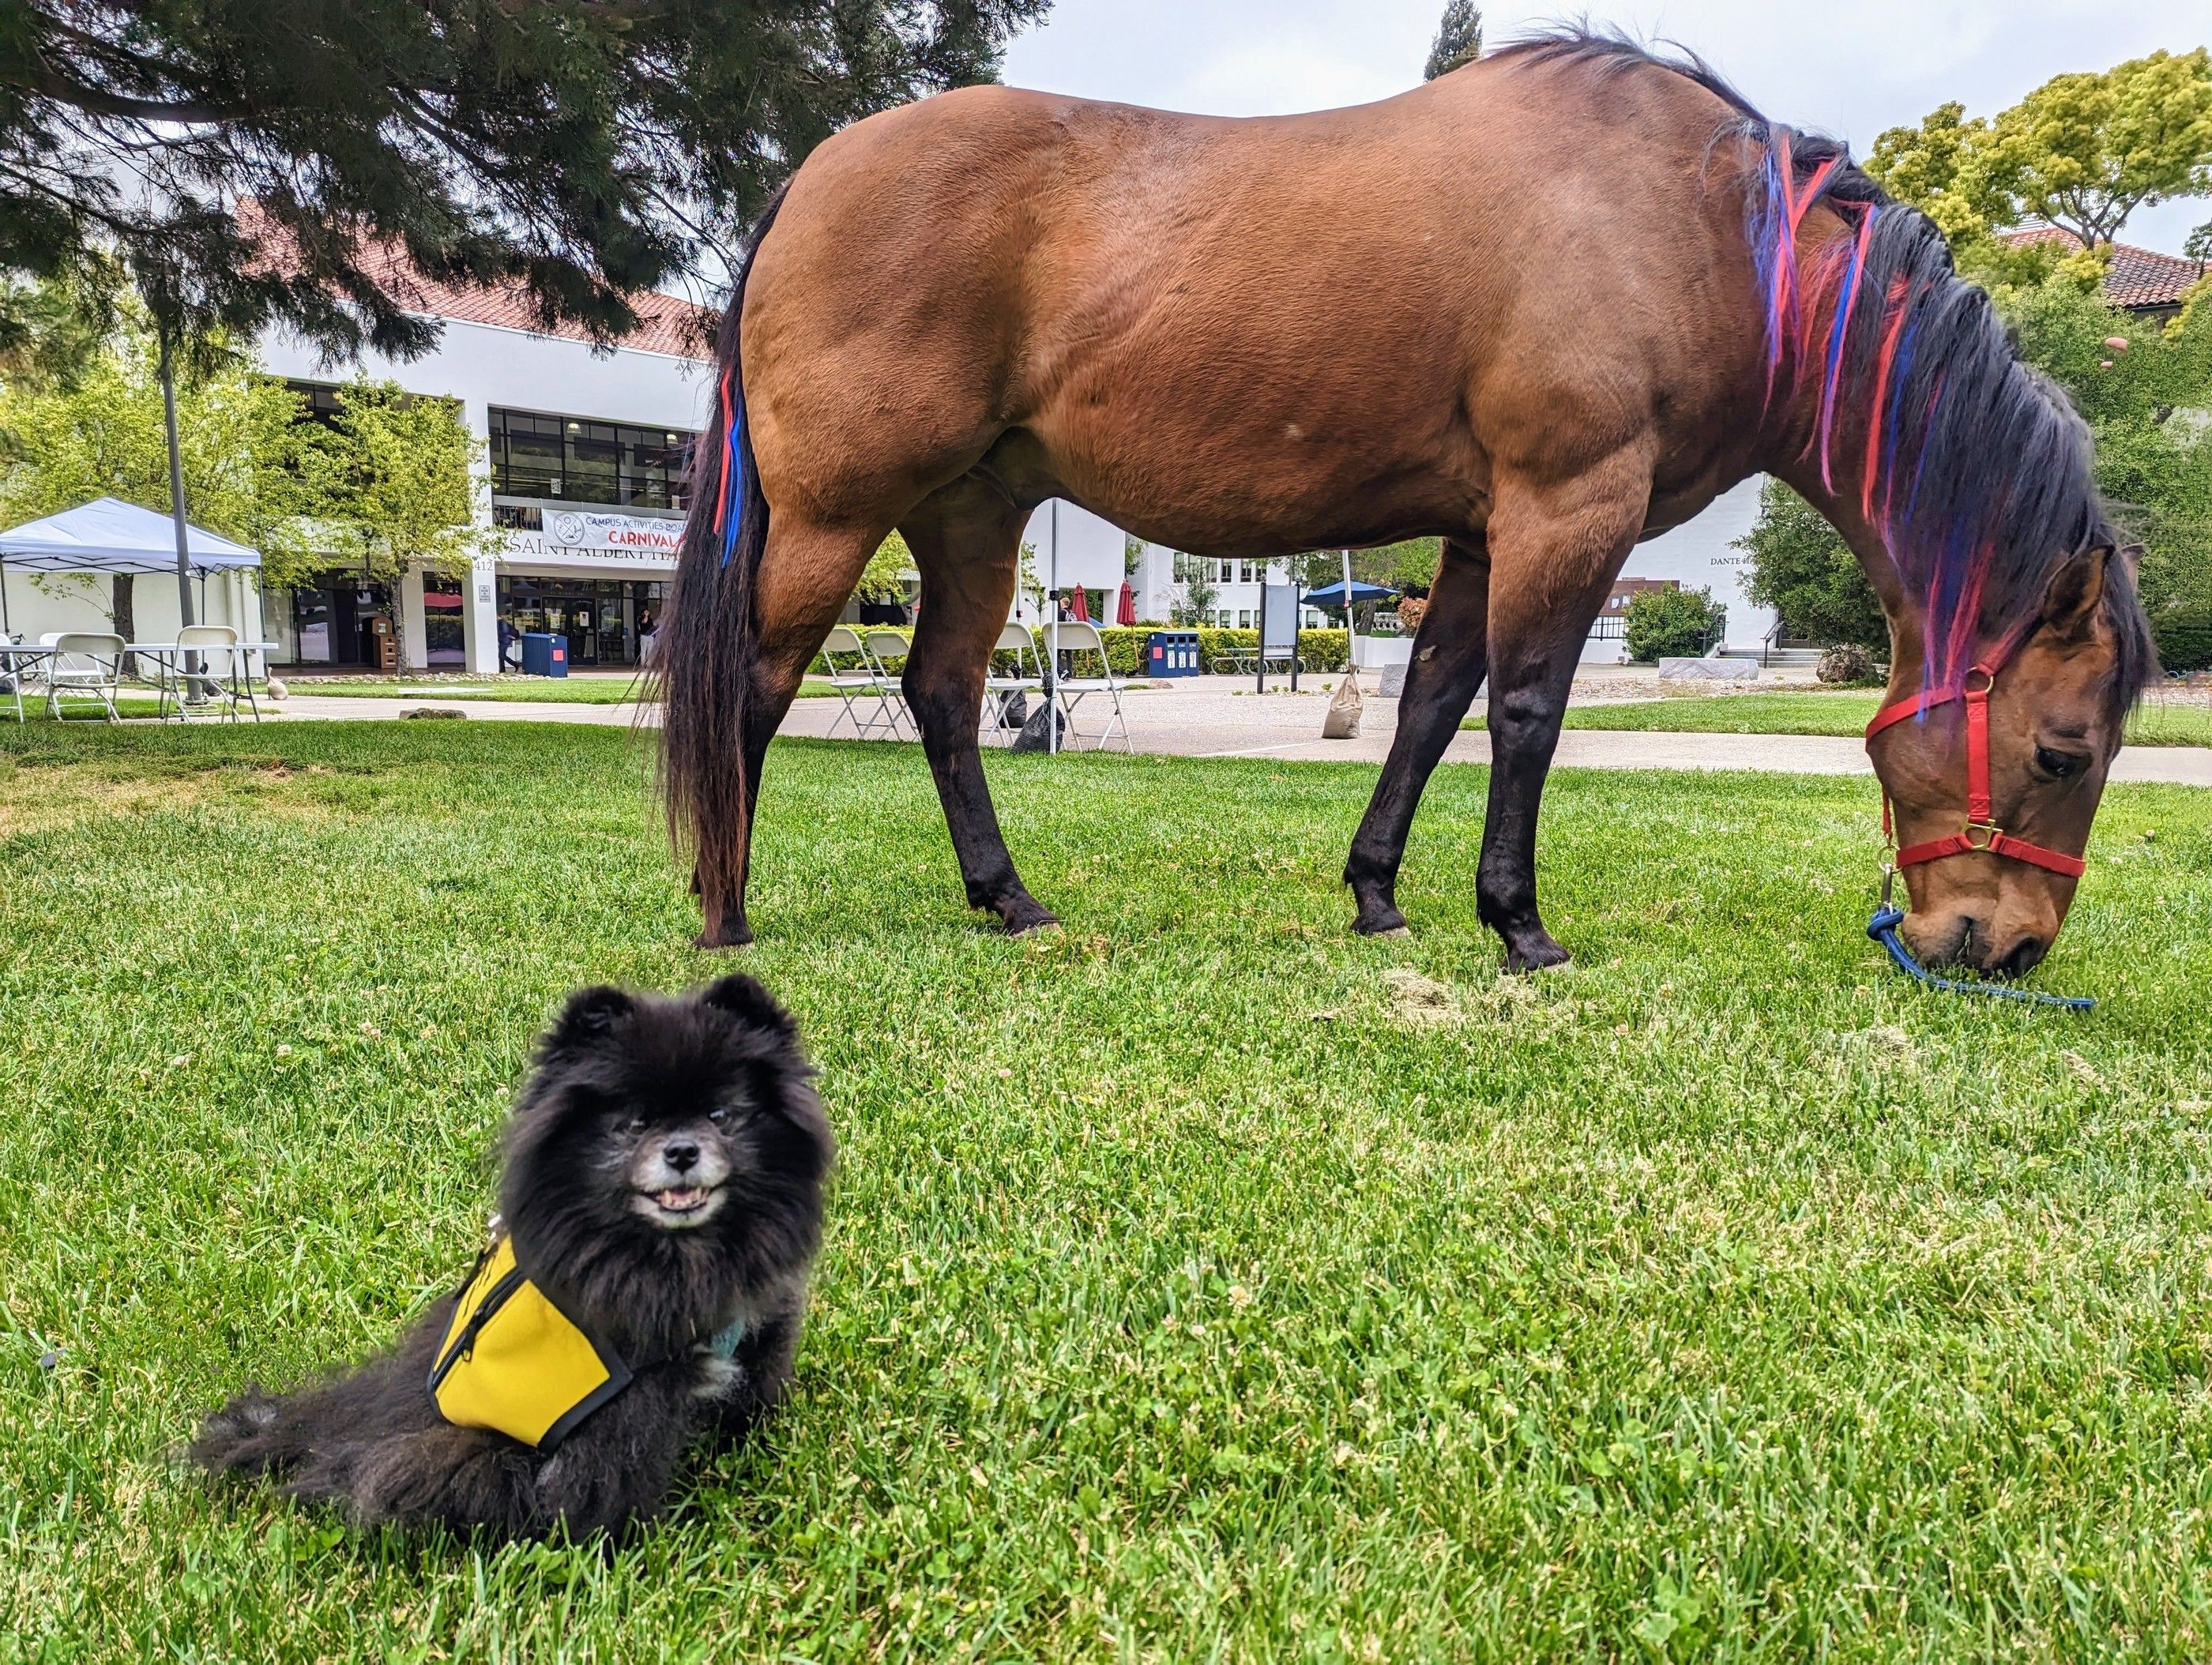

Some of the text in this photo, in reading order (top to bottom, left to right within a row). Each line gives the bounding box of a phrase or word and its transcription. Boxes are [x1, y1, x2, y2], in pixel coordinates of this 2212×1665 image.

[585, 517, 622, 527] CAMPUS
[623, 520, 664, 530] ACTIVITIES
[608, 530, 676, 548] CARNIVAL
[475, 561, 493, 571] 412
